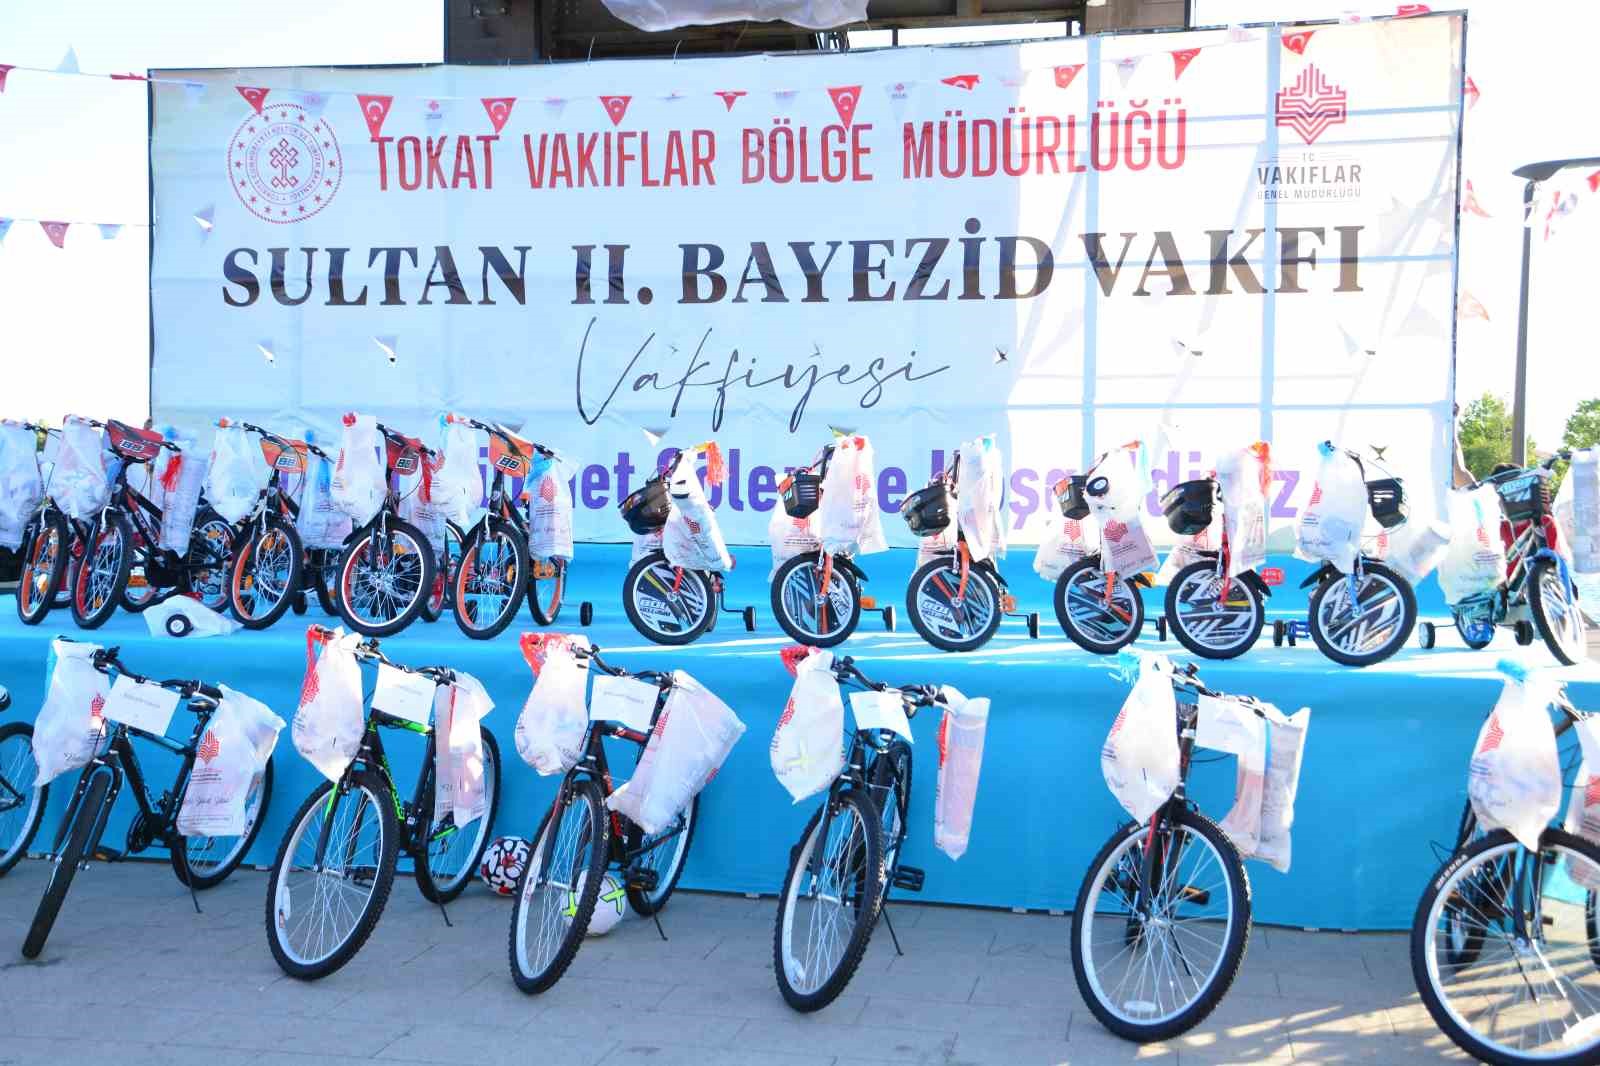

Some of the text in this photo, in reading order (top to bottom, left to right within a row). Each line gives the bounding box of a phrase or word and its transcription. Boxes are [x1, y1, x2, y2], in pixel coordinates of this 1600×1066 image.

[371, 135, 500, 191] TOKAT
[524, 131, 716, 189] VAKIFLAR
[742, 118, 873, 184] BÖLGE
[902, 98, 1187, 179] MÜDÜRLÜĞÜ
[1257, 165, 1361, 185] VAKIFLAR
[222, 217, 1365, 307] SULTAN II. BAYEZİD VAKFI
